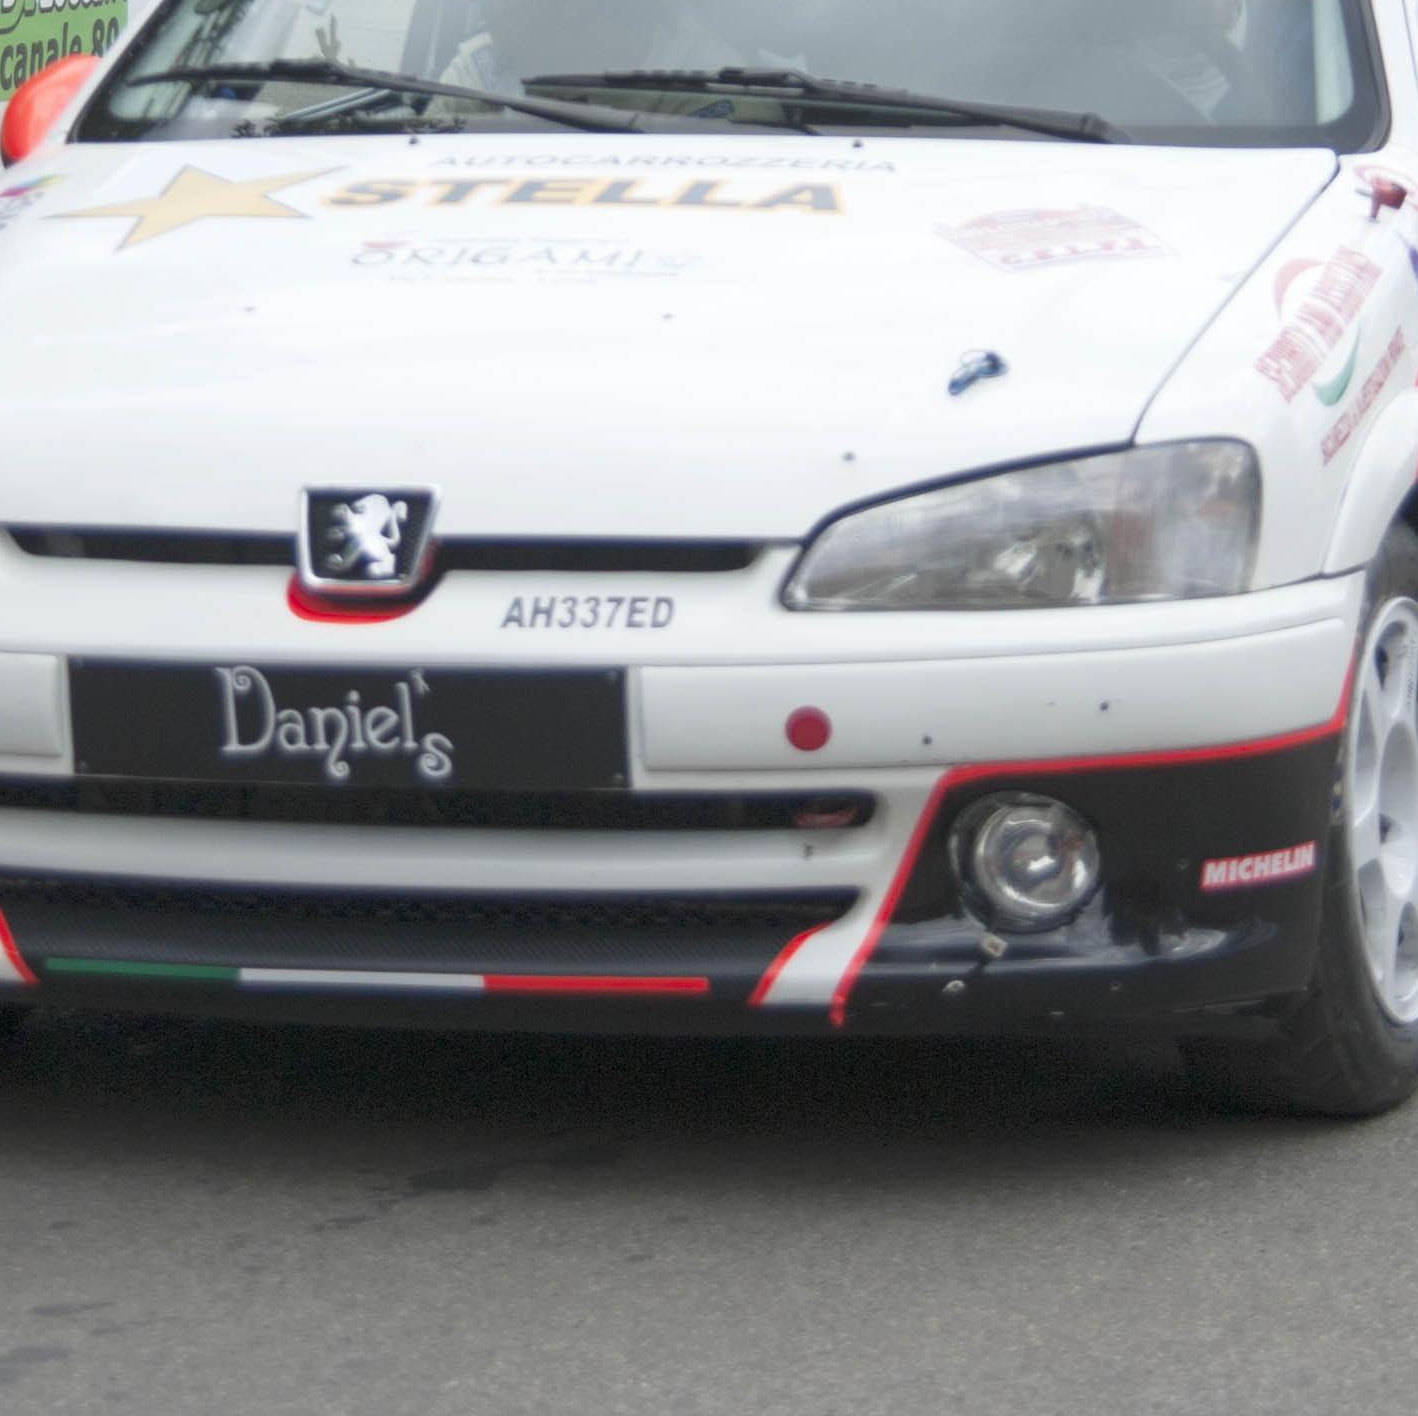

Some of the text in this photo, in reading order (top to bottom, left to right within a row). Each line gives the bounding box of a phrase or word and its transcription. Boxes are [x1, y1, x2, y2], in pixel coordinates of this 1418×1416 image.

[431, 154, 898, 174] AUTOCARROZZERIA
[321, 177, 849, 216] STELLA
[499, 595, 677, 632] AH337ED
[216, 663, 456, 778] Daniel's
[1202, 841, 1317, 886] MICHELIN
